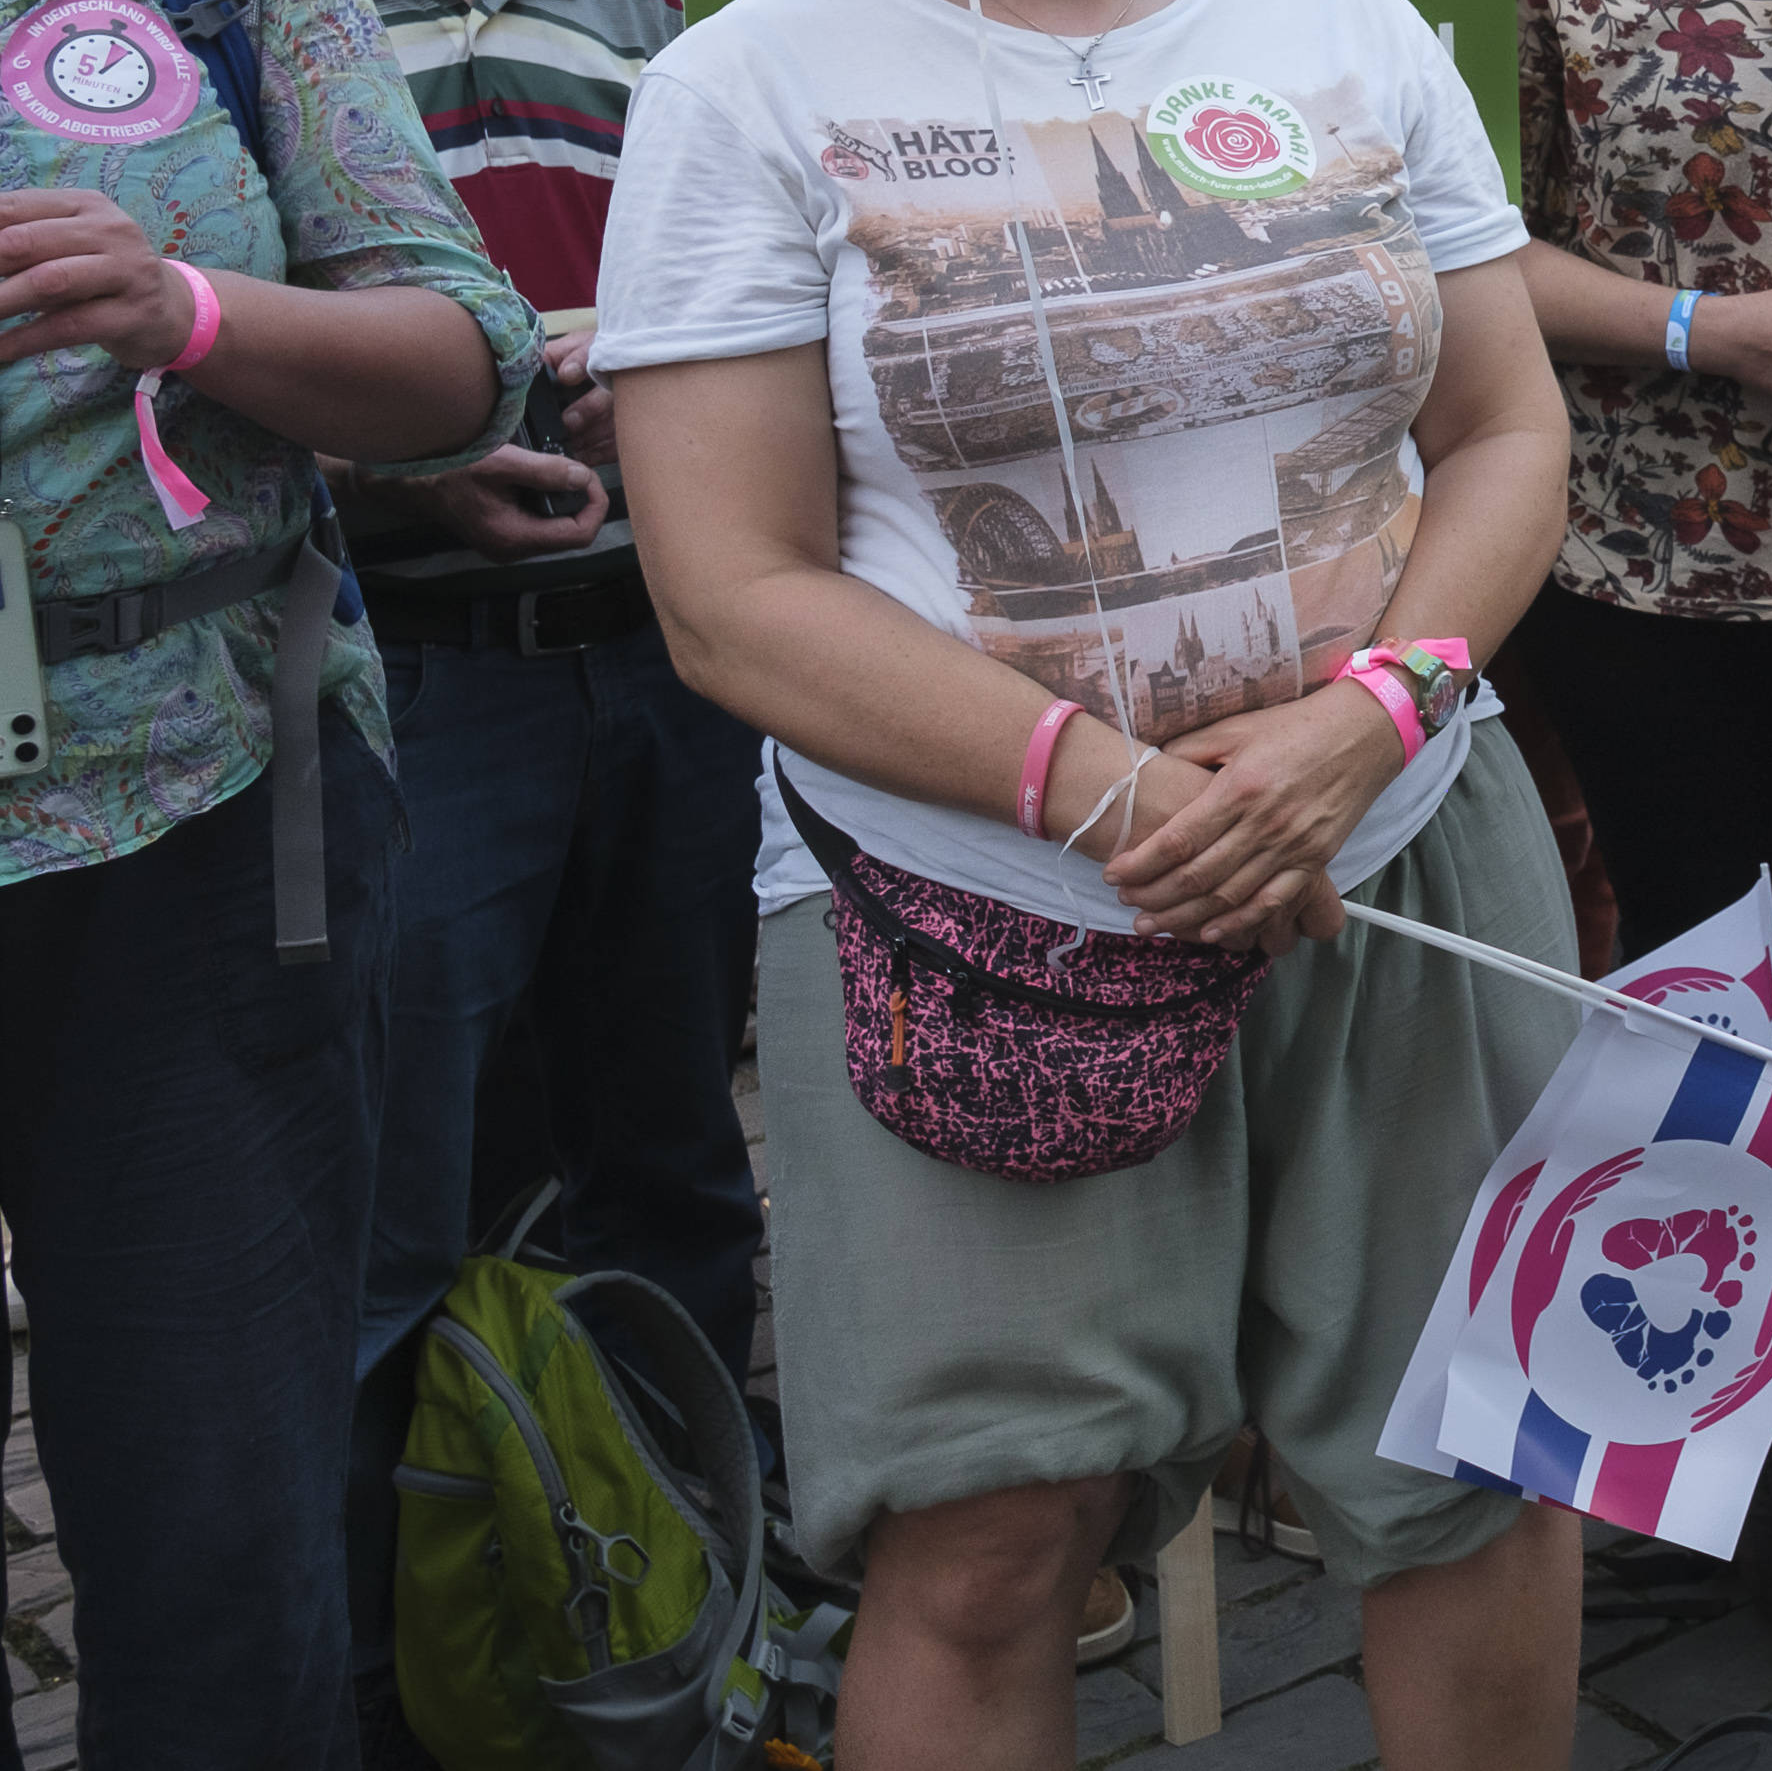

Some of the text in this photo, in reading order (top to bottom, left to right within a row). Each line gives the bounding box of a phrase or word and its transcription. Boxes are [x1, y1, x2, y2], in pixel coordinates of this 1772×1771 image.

[27, 0, 191, 82] IN DEUTSCHLAND WIRD ALLE
[77, 54, 98, 76] 5
[13, 81, 162, 138] EIN KIND ABGETRIEBEN
[72, 75, 121, 94] MINUTEN
[1155, 82, 1310, 166] DANKE MAMA!
